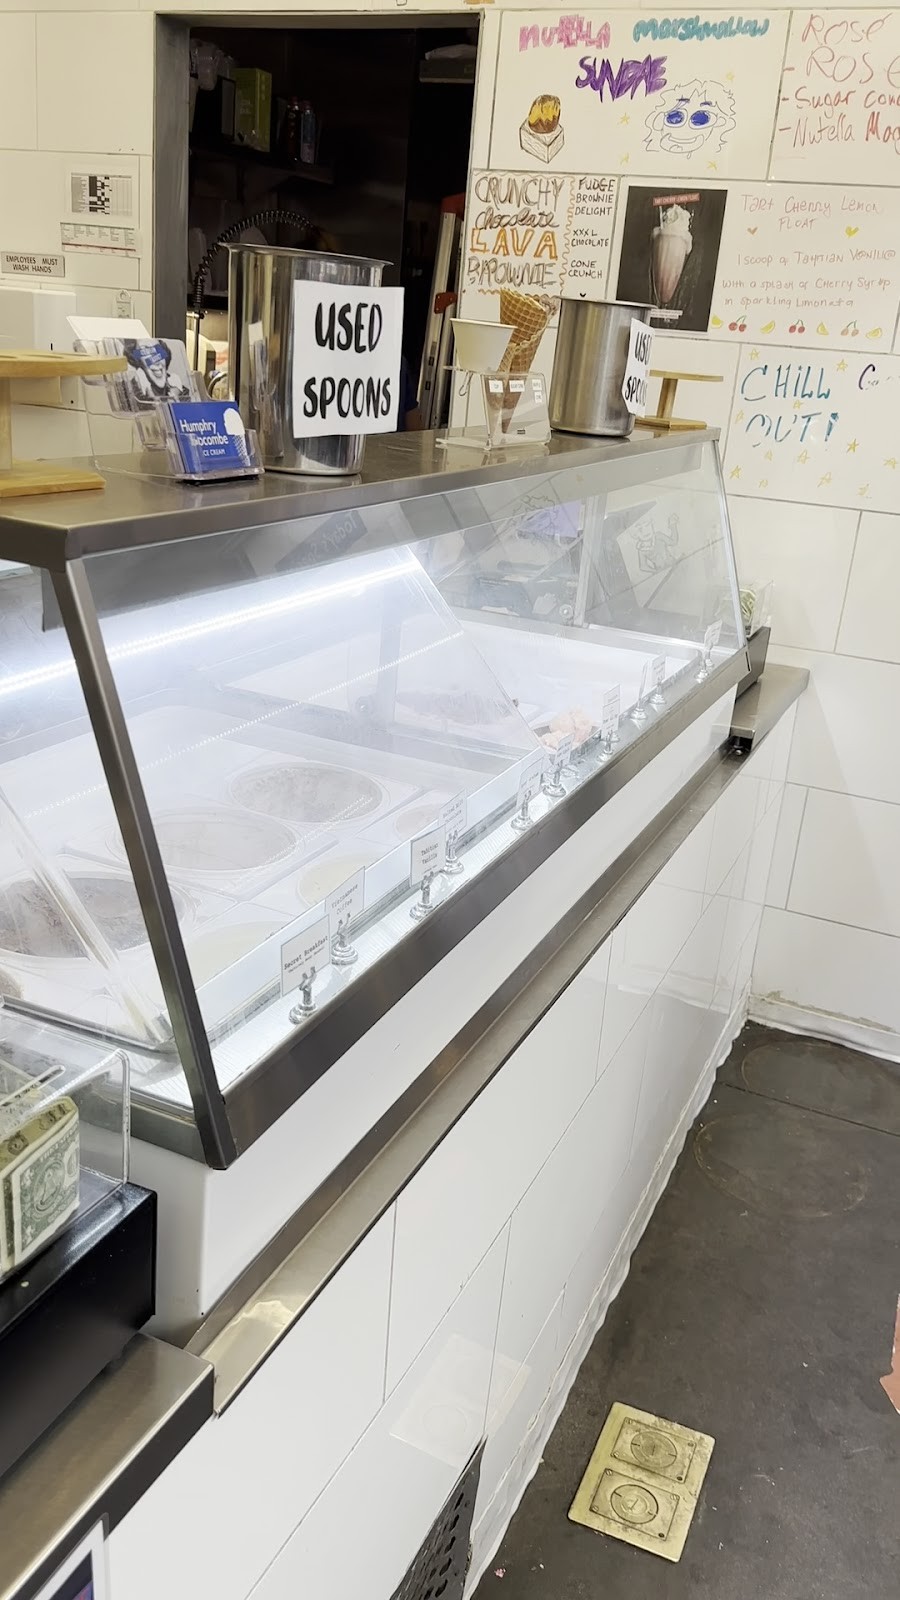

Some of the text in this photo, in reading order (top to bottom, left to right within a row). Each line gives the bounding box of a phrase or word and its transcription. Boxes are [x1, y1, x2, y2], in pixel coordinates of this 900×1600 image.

[793, 112, 855, 148] Nutella
[578, 177, 616, 192] FUDGE
[475, 176, 564, 212] CRUNCHY
[576, 192, 614, 204] BROWNIE
[575, 206, 613, 216] DELIGHT
[470, 228, 558, 261] LAVA
[6, 255, 58, 266] EMPLOYEES MUST
[571, 260, 597, 269] CONE
[12, 264, 52, 274] WASH HANDS
[568, 269, 603, 279] CRUNCH
[315, 302, 383, 353] USED
[303, 376, 391, 419] SPOONS
[179, 418, 216, 435] Humphry
[284, 953, 302, 970] Secret
[304, 935, 329, 957] Breakfast
